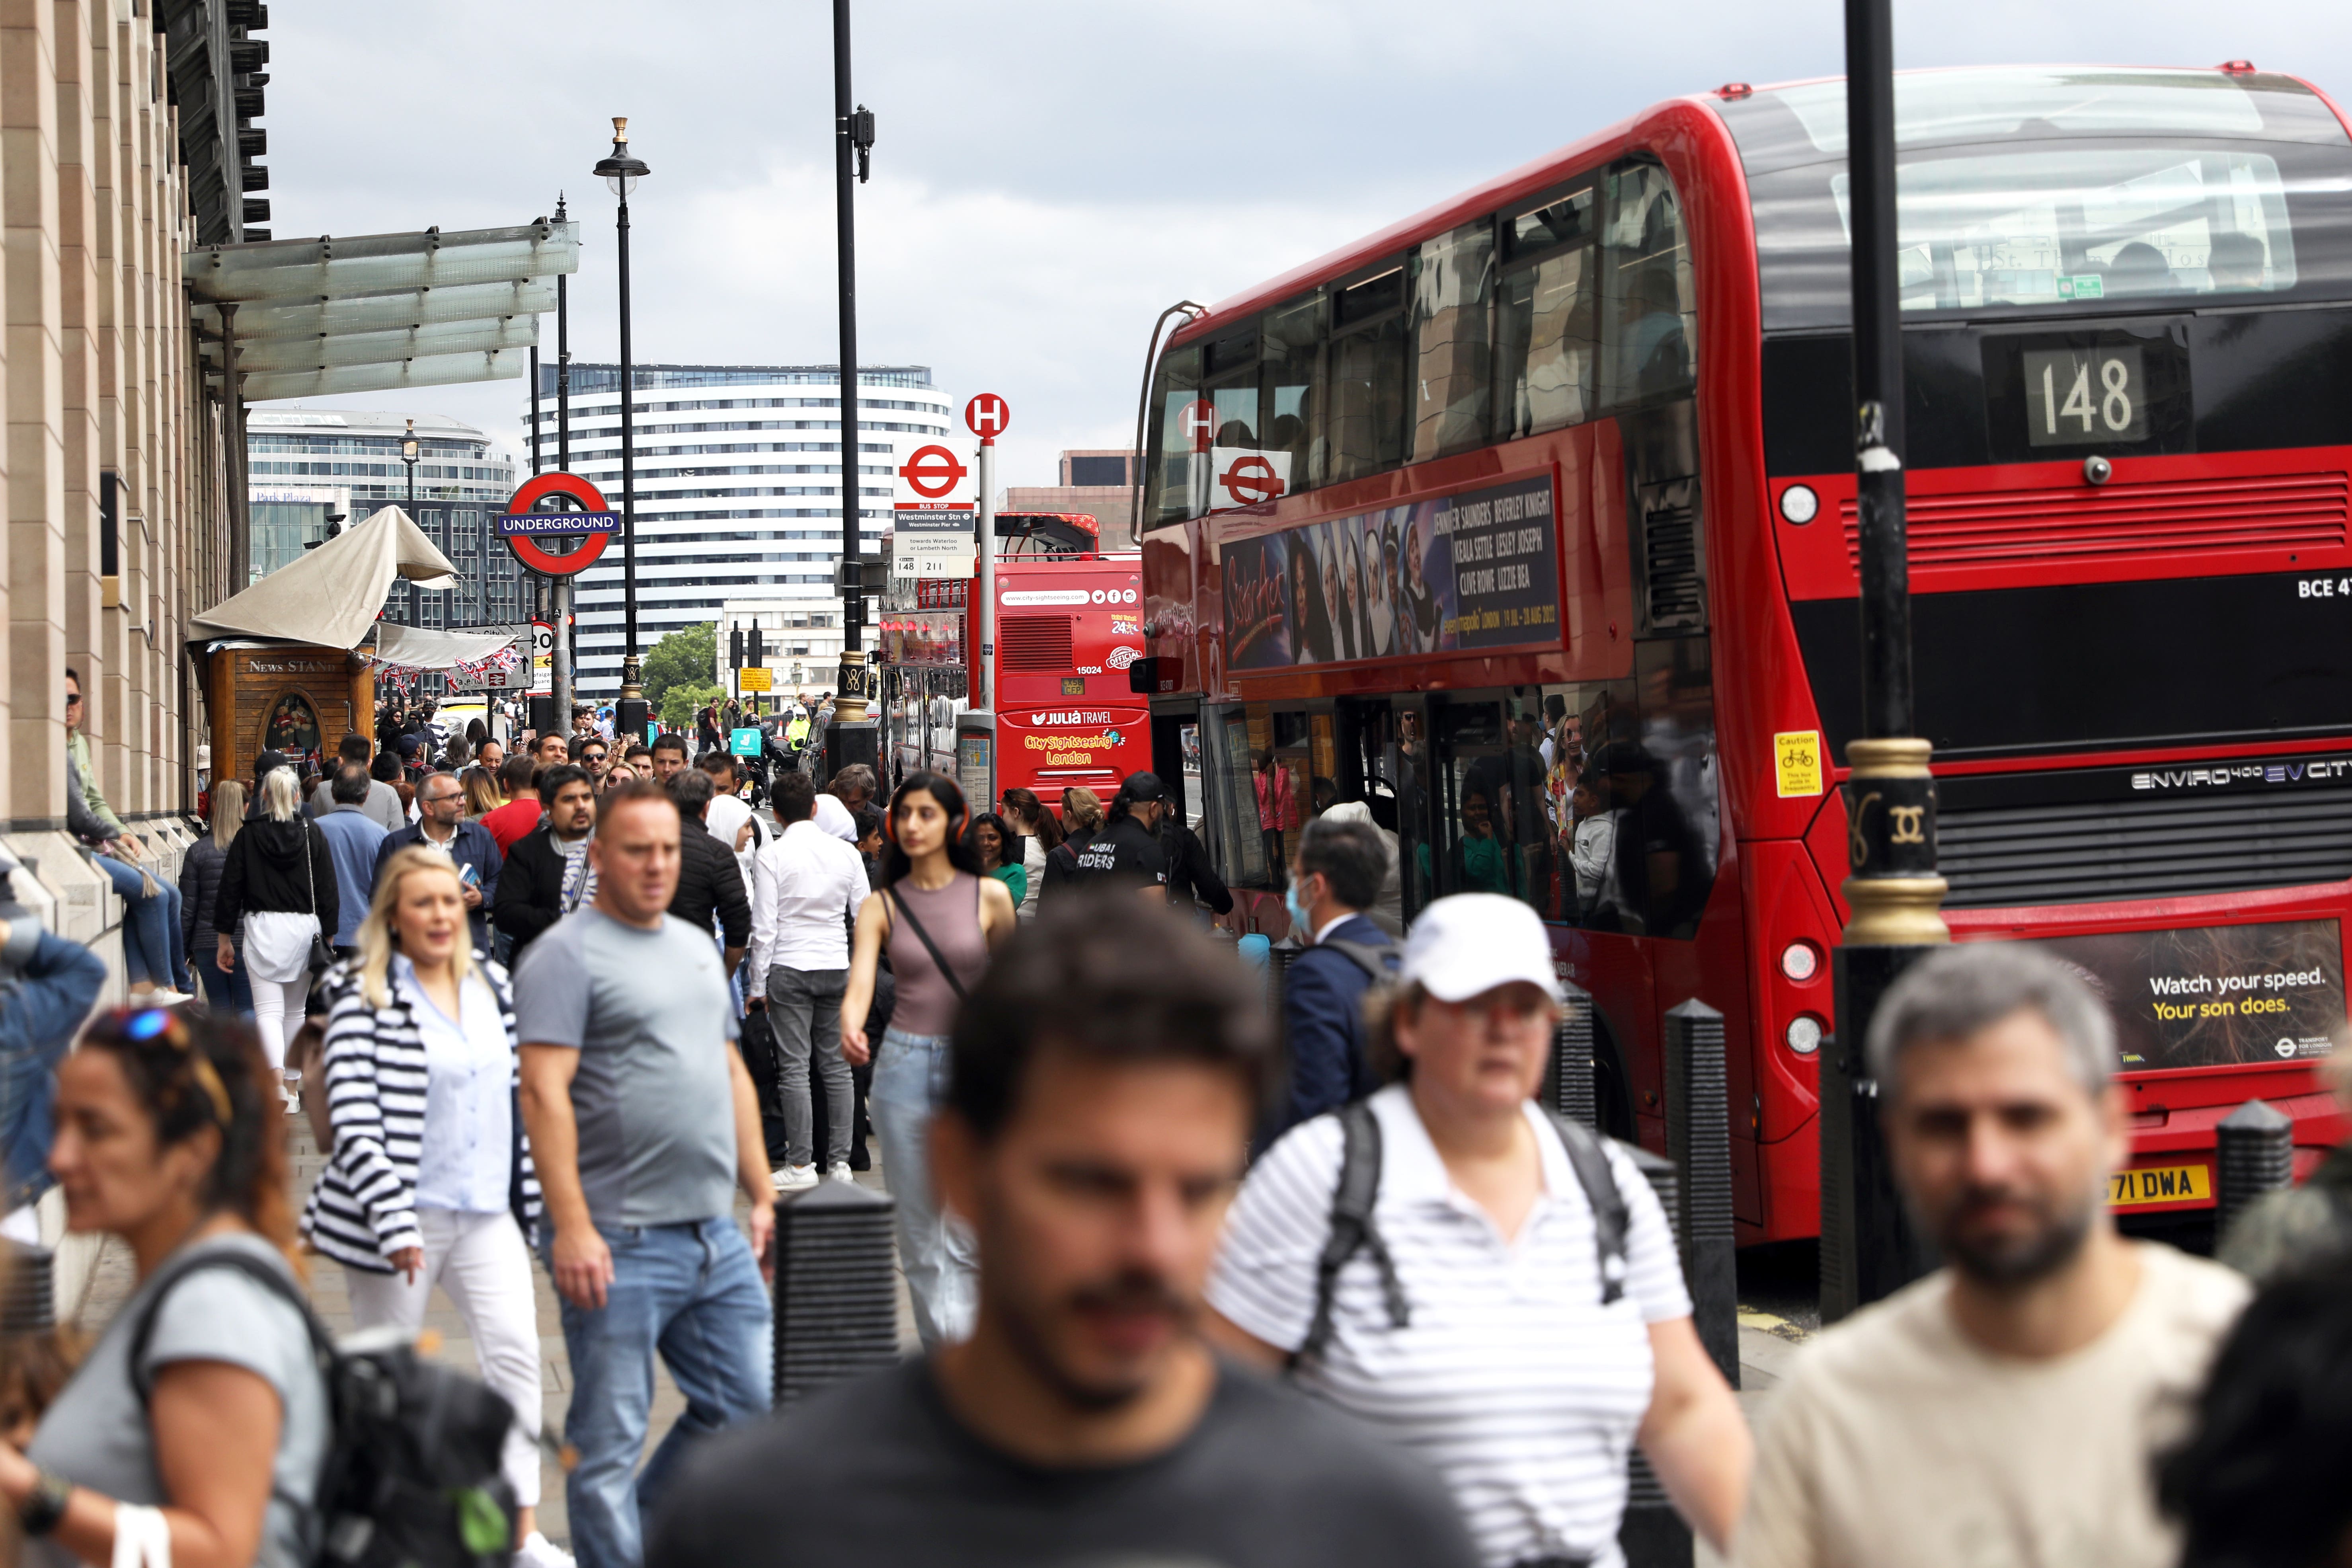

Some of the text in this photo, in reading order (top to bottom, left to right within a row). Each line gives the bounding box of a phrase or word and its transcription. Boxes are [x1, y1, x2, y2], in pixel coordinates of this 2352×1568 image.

[2043, 359, 2132, 434] 148
[974, 400, 1000, 431] H
[257, 492, 311, 502] Park Plaza
[1461, 501, 1491, 530] SAUNDERS
[1494, 495, 1523, 523] BEVERLEY
[1525, 490, 1550, 518] KNIGHT
[504, 517, 614, 530] UNDERGROUND
[1454, 527, 1543, 564] KEALA SETTLE LESLEY JOSEPH
[1460, 564, 1530, 596] CLIVE ROWE LIZZIE BEA
[2298, 579, 2333, 598] BCE
[1160, 609, 1172, 625] RATP
[1112, 621, 1126, 634] 24
[1110, 651, 1140, 665] OFFICIAL
[1082, 712, 1112, 724] TRAVEL
[1779, 737, 1814, 745] Caution
[1047, 751, 1091, 765] London
[1077, 853, 1116, 870] RIDERS
[2149, 967, 2326, 995] Watch your speed.
[2153, 997, 2291, 1020] Your son does.
[2142, 1170, 2193, 1197] DWA
